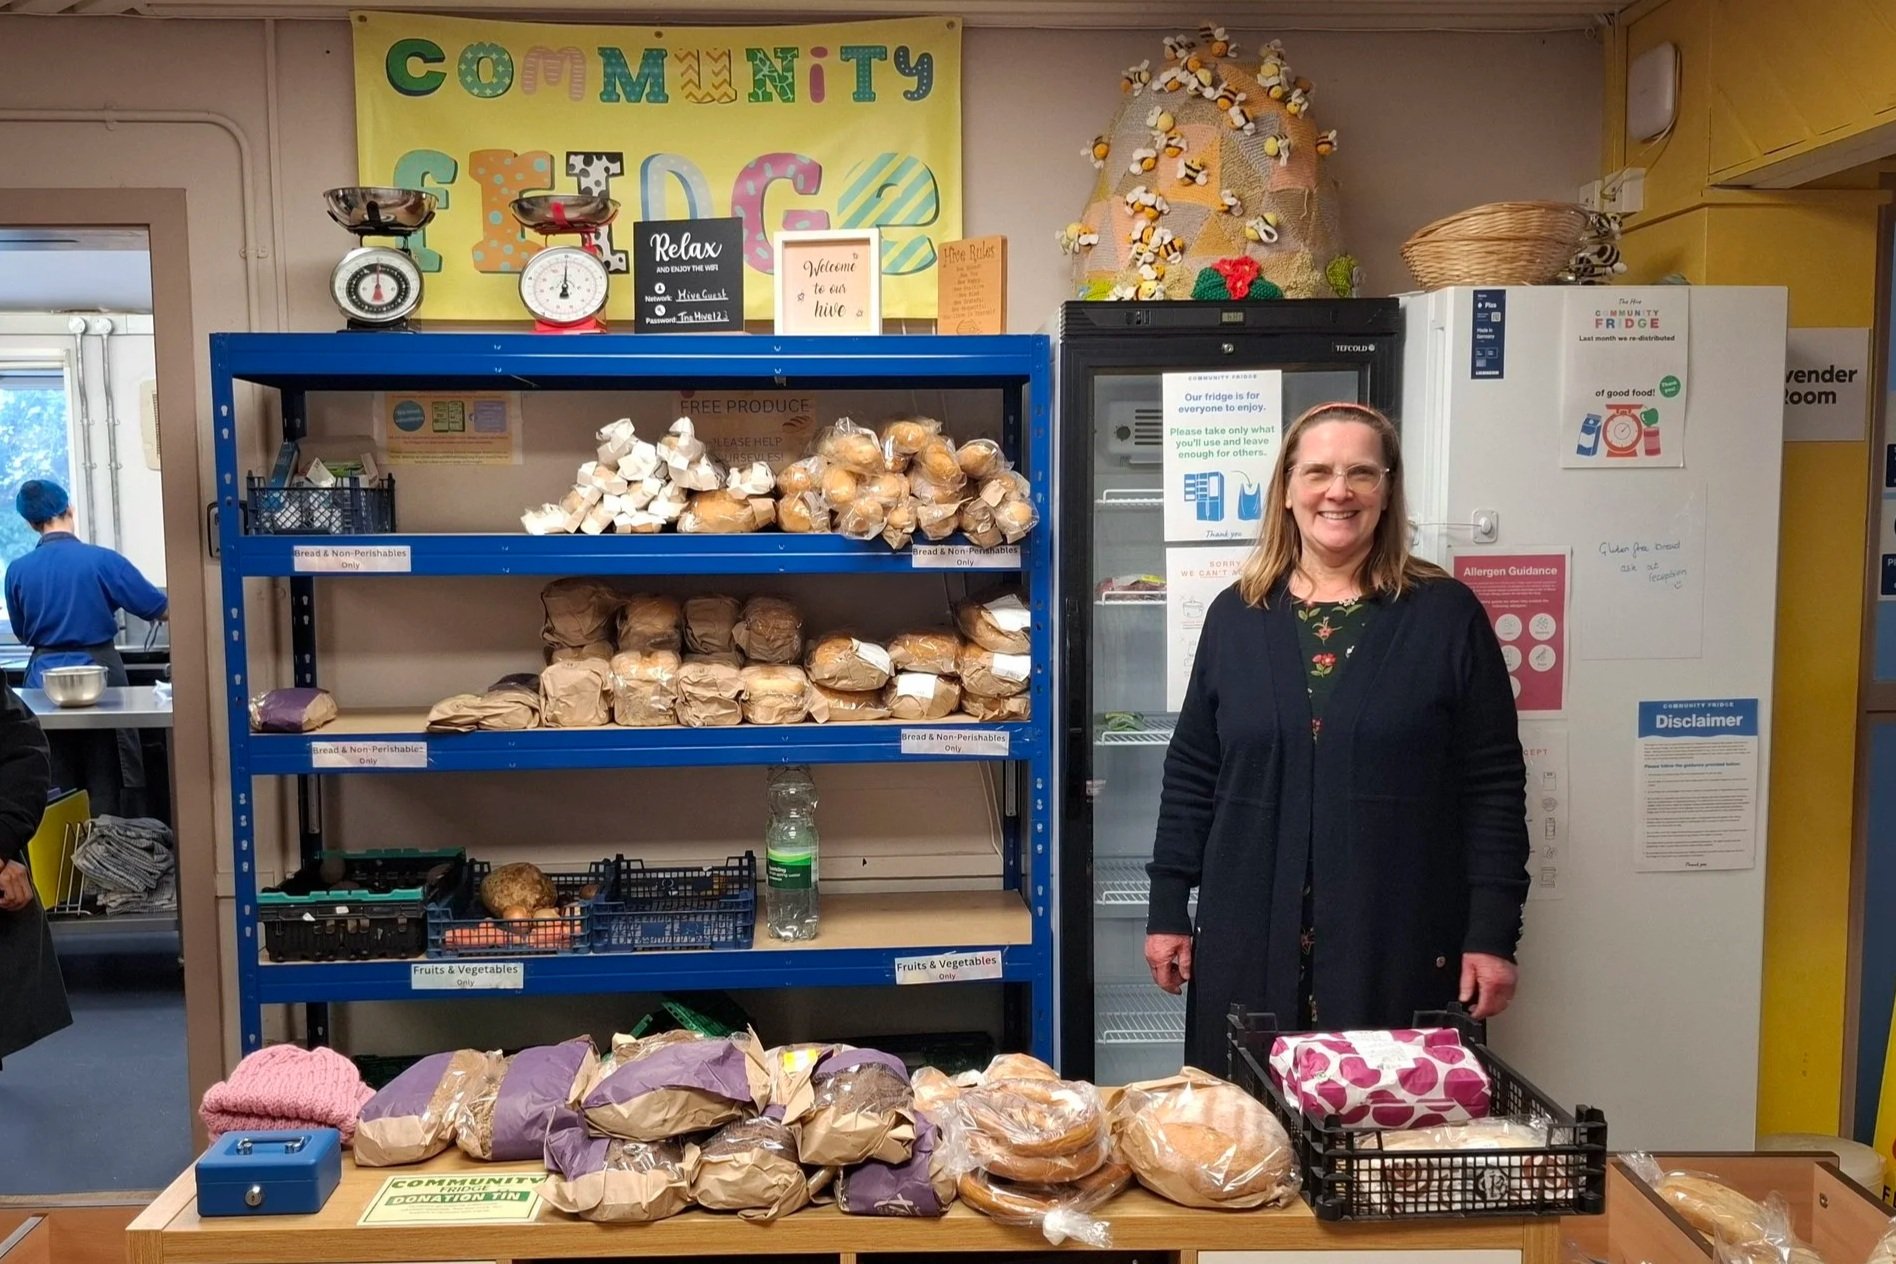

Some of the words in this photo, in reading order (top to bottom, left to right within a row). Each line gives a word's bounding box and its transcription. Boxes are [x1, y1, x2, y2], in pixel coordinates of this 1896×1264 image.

[650, 232, 722, 262] Relax
[970, 240, 995, 262] Rules
[657, 266, 670, 274] AND
[671, 265, 691, 273] ENJOY
[692, 264, 704, 272] THE
[803, 258, 856, 278] Welcome
[814, 282, 825, 295] to
[830, 283, 846, 294] our
[814, 300, 846, 318] hive
[1595, 318, 1660, 329] FRIDGE
[1185, 393, 1202, 402] Our
[1205, 392, 1233, 402] fridge
[1235, 392, 1244, 400] is
[1246, 391, 1260, 400] for
[1596, 389, 1605, 397] of
[1607, 390, 1629, 399] good
[1632, 389, 1656, 397] food!
[680, 400, 722, 414] FREE
[727, 399, 810, 414] PRODUCE
[1179, 405, 1223, 415] everyone
[1226, 404, 1235, 412] to
[1237, 403, 1266, 413] enjoy.
[1170, 428, 1202, 436] Please
[1205, 427, 1226, 436] take
[1228, 426, 1248, 436] only
[1250, 425, 1275, 434] what
[754, 436, 783, 447] HELP
[1176, 439, 1201, 450] you'll
[1223, 438, 1242, 446] and
[1244, 437, 1269, 445] leave
[1178, 450, 1214, 460] enough
[1217, 449, 1230, 458] for
[1232, 448, 1267, 458] others.
[1206, 530, 1228, 538] Thank
[294, 550, 321, 558] Bread
[324, 550, 330, 558] &
[332, 550, 407, 558] Non-Perishables
[1464, 567, 1506, 578] Allergen
[1508, 566, 1558, 576] Guidance
[1656, 714, 1743, 728] Disclaimer
[936, 734, 1006, 742] Non-Perishables
[945, 745, 962, 753] Only
[897, 961, 927, 972] Fruits
[930, 961, 937, 970] &
[939, 956, 997, 970] Vegetables
[413, 965, 445, 975] Fruits
[448, 965, 456, 975] &
[458, 965, 518, 976] Vegetables
[939, 973, 956, 981] Only
[457, 979, 475, 988] Only
[391, 1177, 546, 1189] COMMUNITY
[440, 1185, 489, 1193] FRIDGE
[392, 1192, 486, 1205] DONATION
[491, 1192, 520, 1201] TIN
